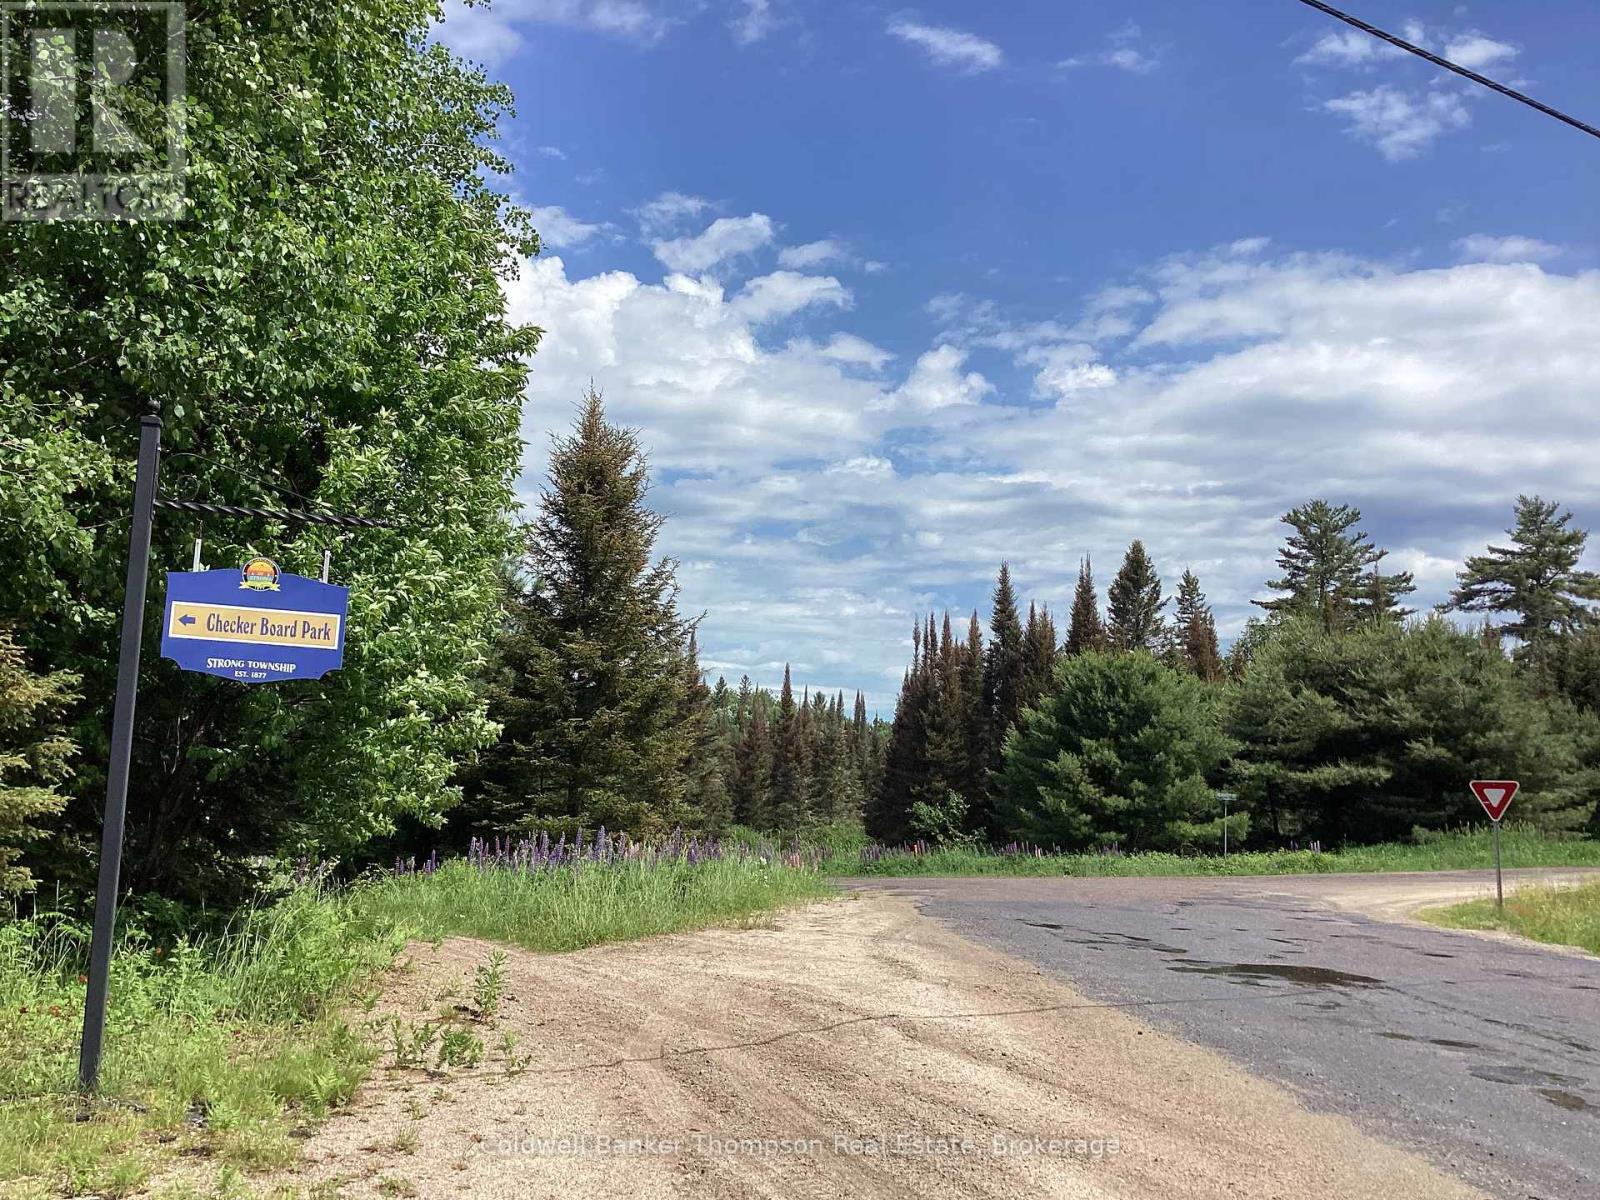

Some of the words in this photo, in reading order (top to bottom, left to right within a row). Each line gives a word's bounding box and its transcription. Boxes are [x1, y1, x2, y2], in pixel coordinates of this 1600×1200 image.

[206, 612, 257, 635] Checker
[260, 617, 298, 638] Board
[301, 620, 331, 641] Park
[206, 657, 245, 669] STRONG
[247, 660, 297, 674] TOWNSHIP
[234, 670, 249, 678] EST.
[251, 671, 267, 679] 1877
